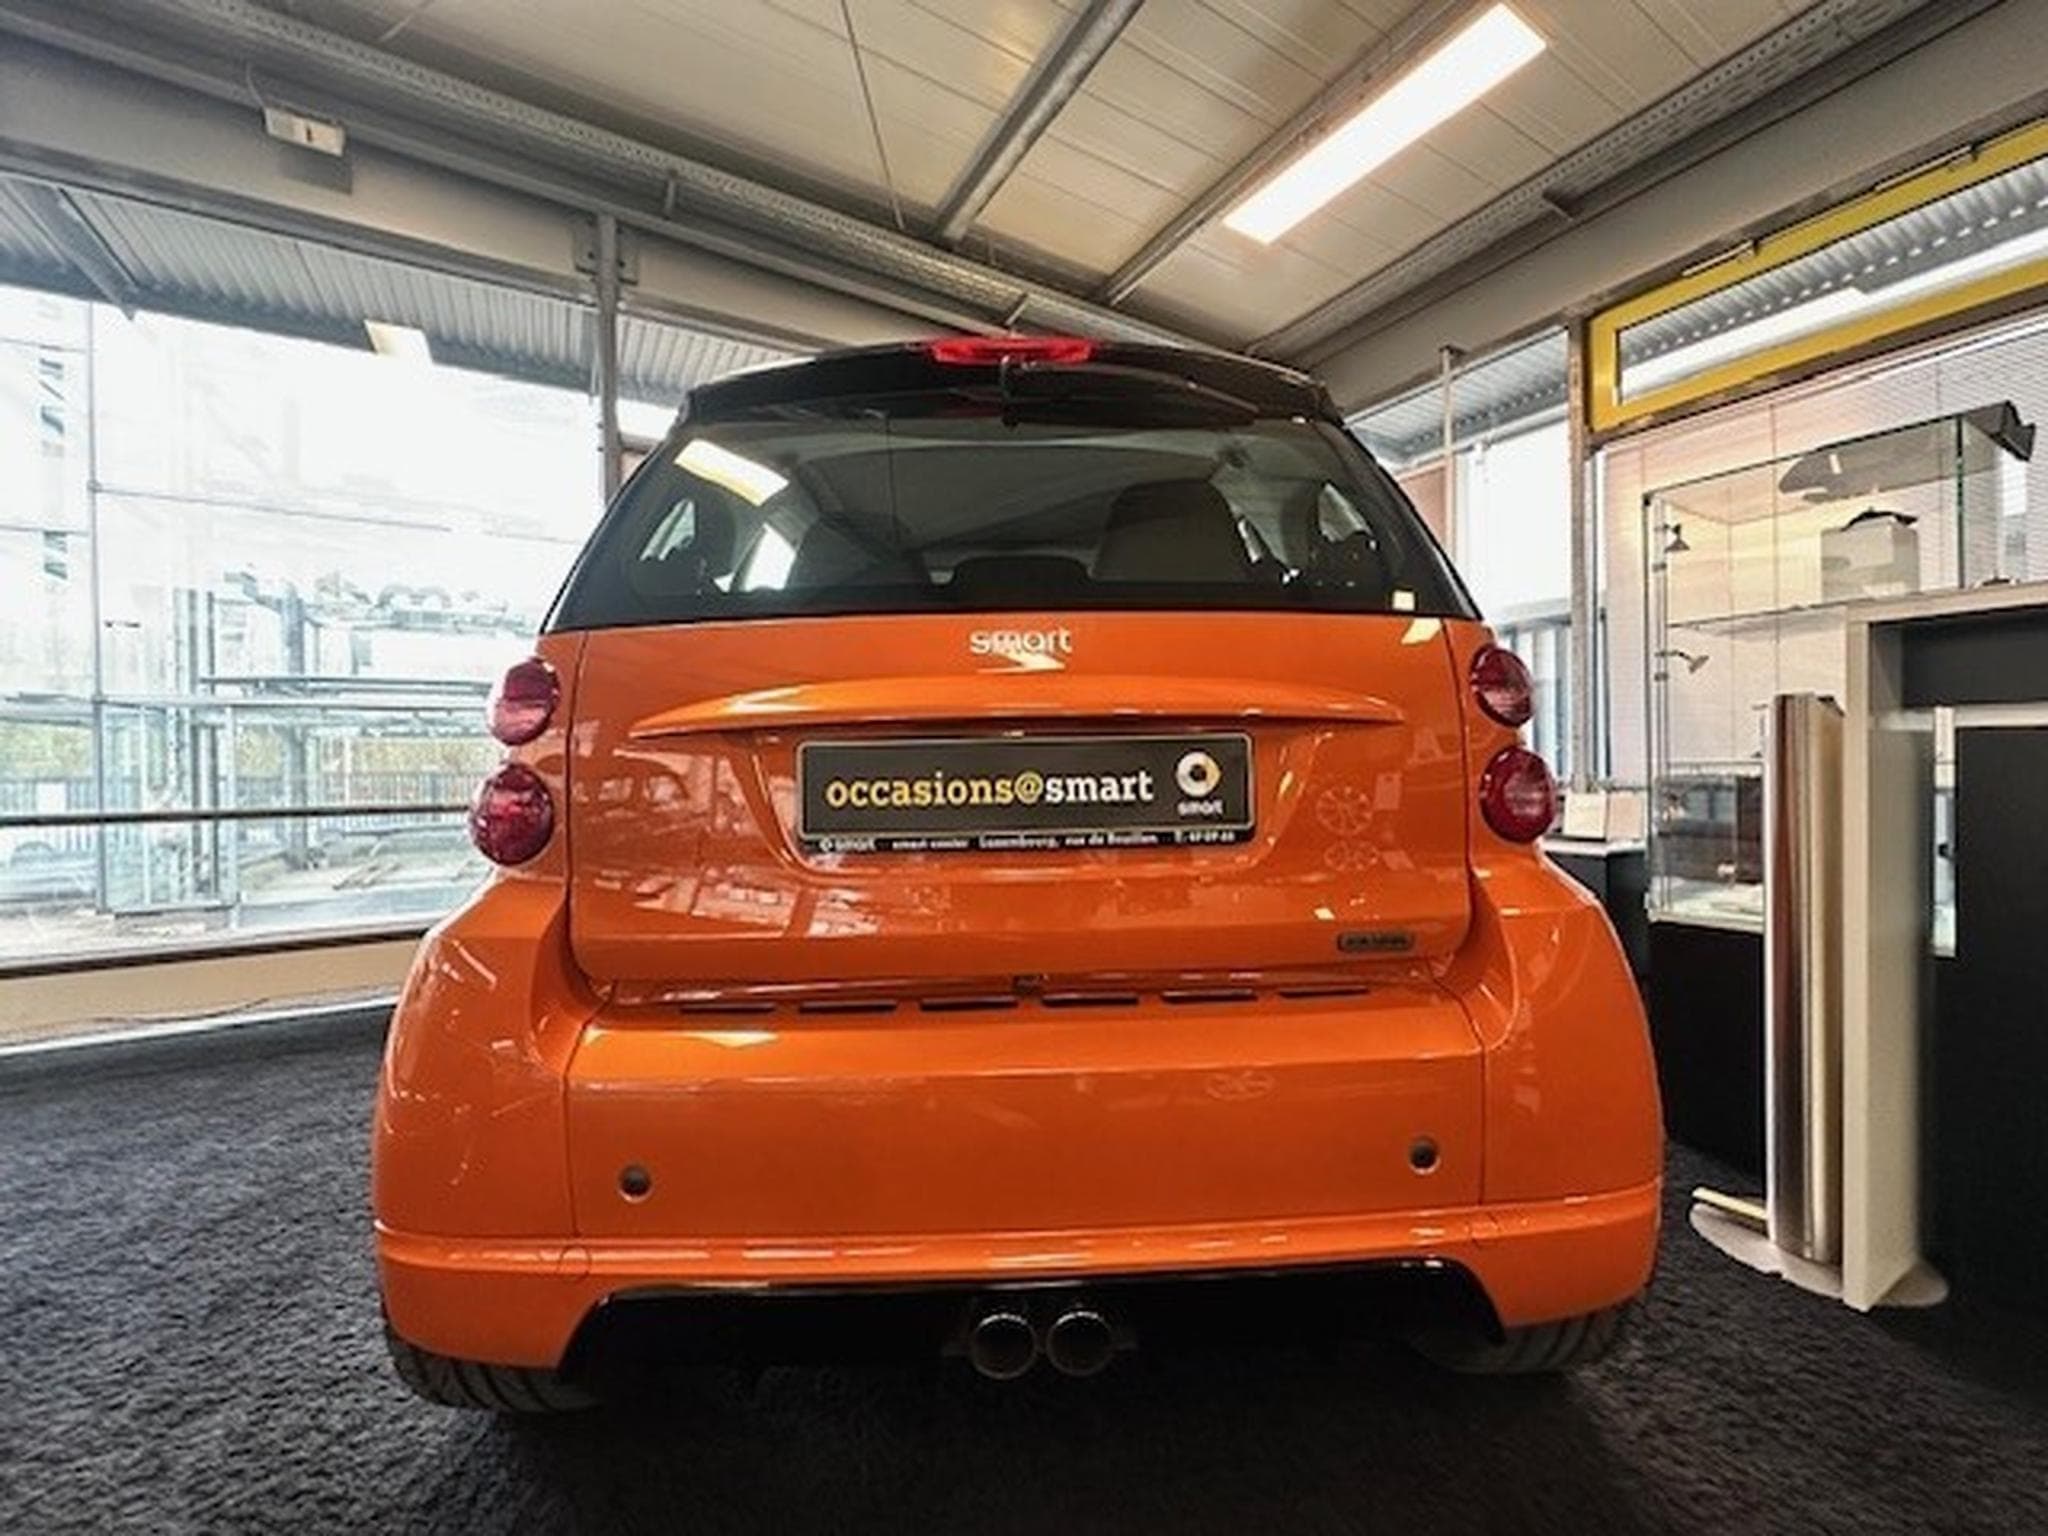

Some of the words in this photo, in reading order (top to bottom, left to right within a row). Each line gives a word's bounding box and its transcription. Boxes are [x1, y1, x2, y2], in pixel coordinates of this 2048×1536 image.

[970, 627, 1072, 654] smart
[826, 771, 1154, 807] occasions@smart
[1178, 800, 1224, 815] smart
